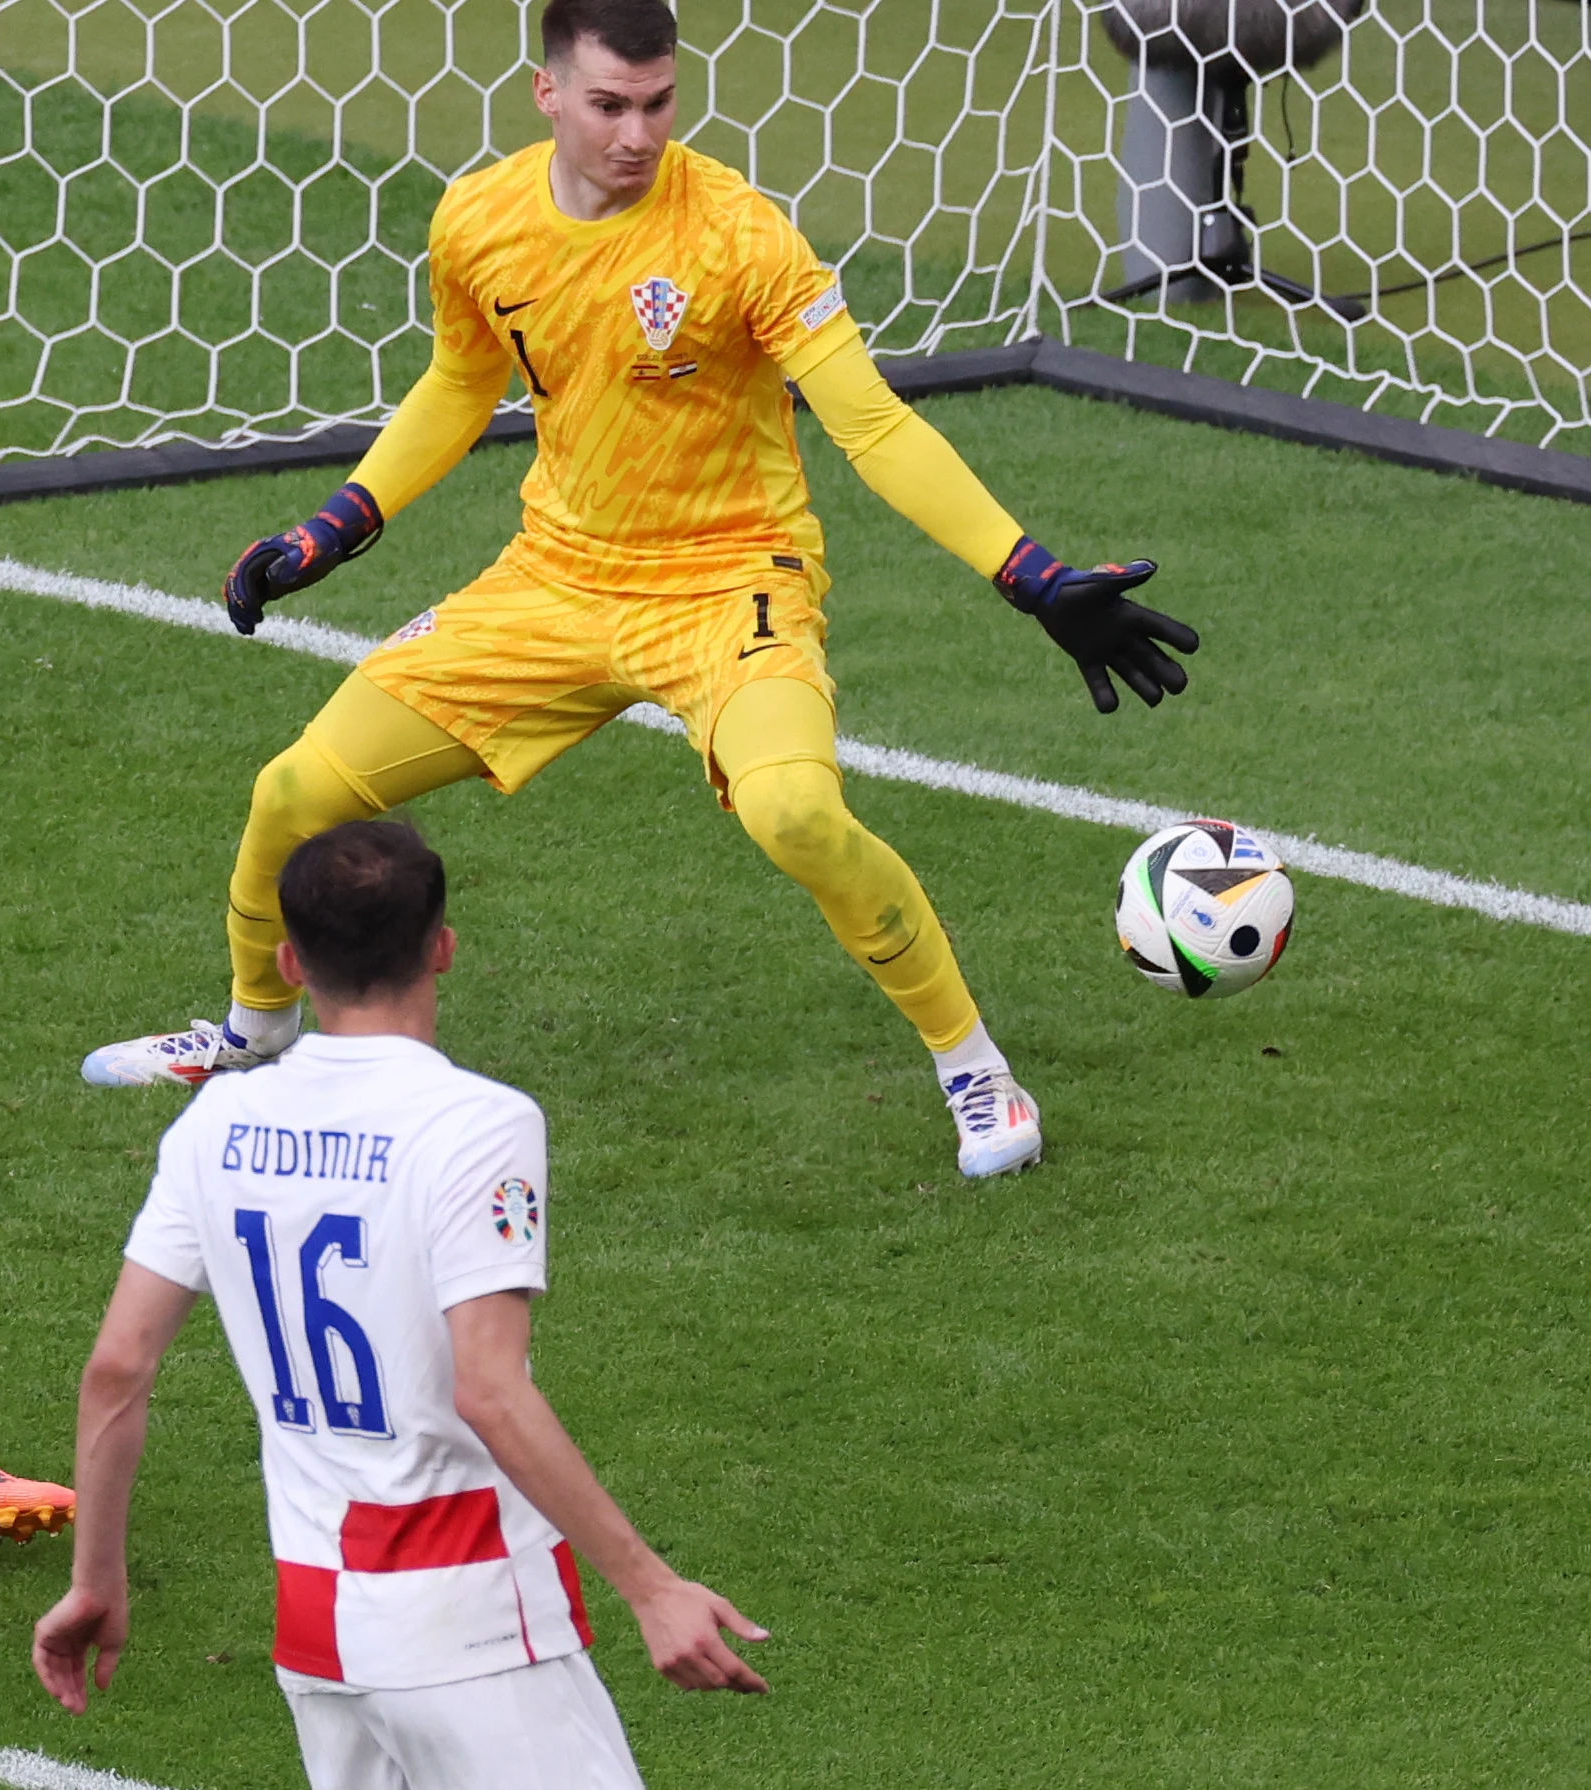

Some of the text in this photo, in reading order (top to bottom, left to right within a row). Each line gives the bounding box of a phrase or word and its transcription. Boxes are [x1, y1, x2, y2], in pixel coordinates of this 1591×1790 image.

[510, 329, 551, 398] 1
[752, 592, 776, 639] 1
[220, 1122, 397, 1184] BUDIMIR
[234, 1207, 398, 1440] 16
